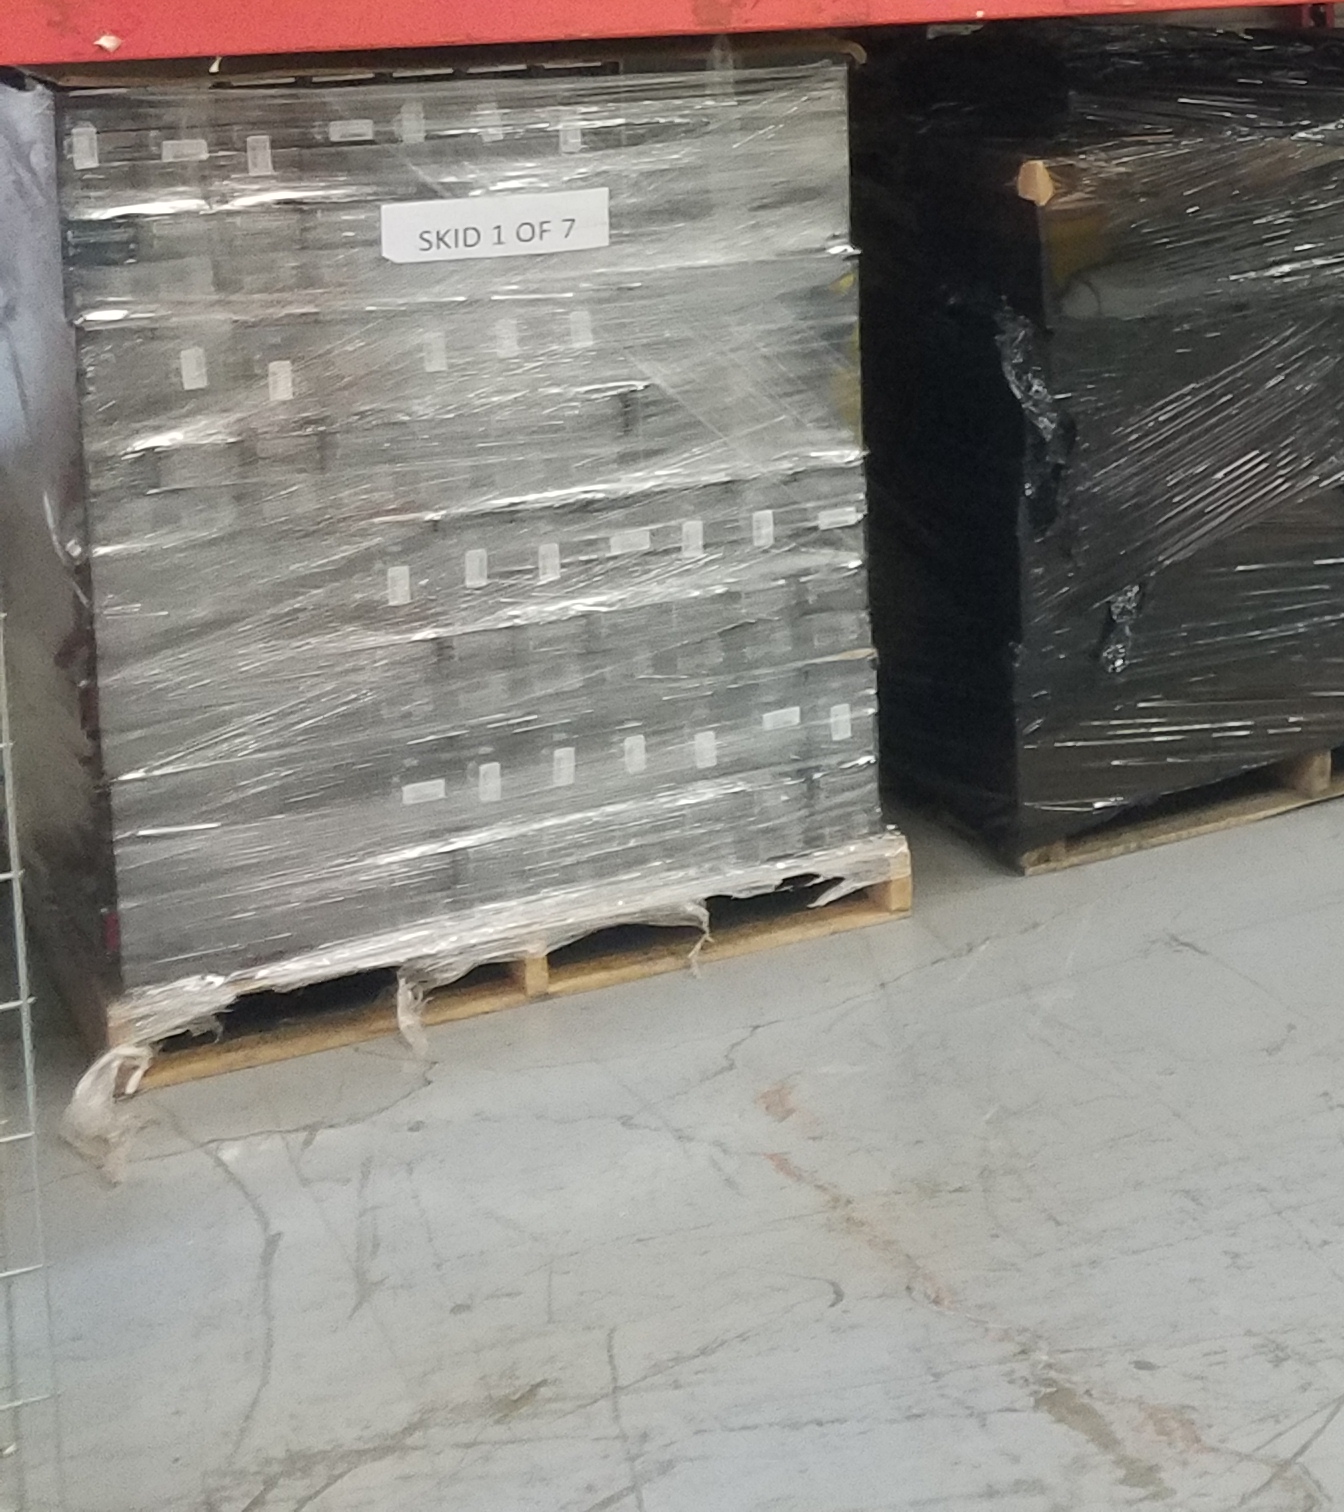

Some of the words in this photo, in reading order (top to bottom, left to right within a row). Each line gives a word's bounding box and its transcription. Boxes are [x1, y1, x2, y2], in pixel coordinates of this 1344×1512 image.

[418, 226, 481, 251] SKID
[492, 225, 505, 246] 1
[516, 220, 552, 243] OF
[561, 218, 576, 239] 7
